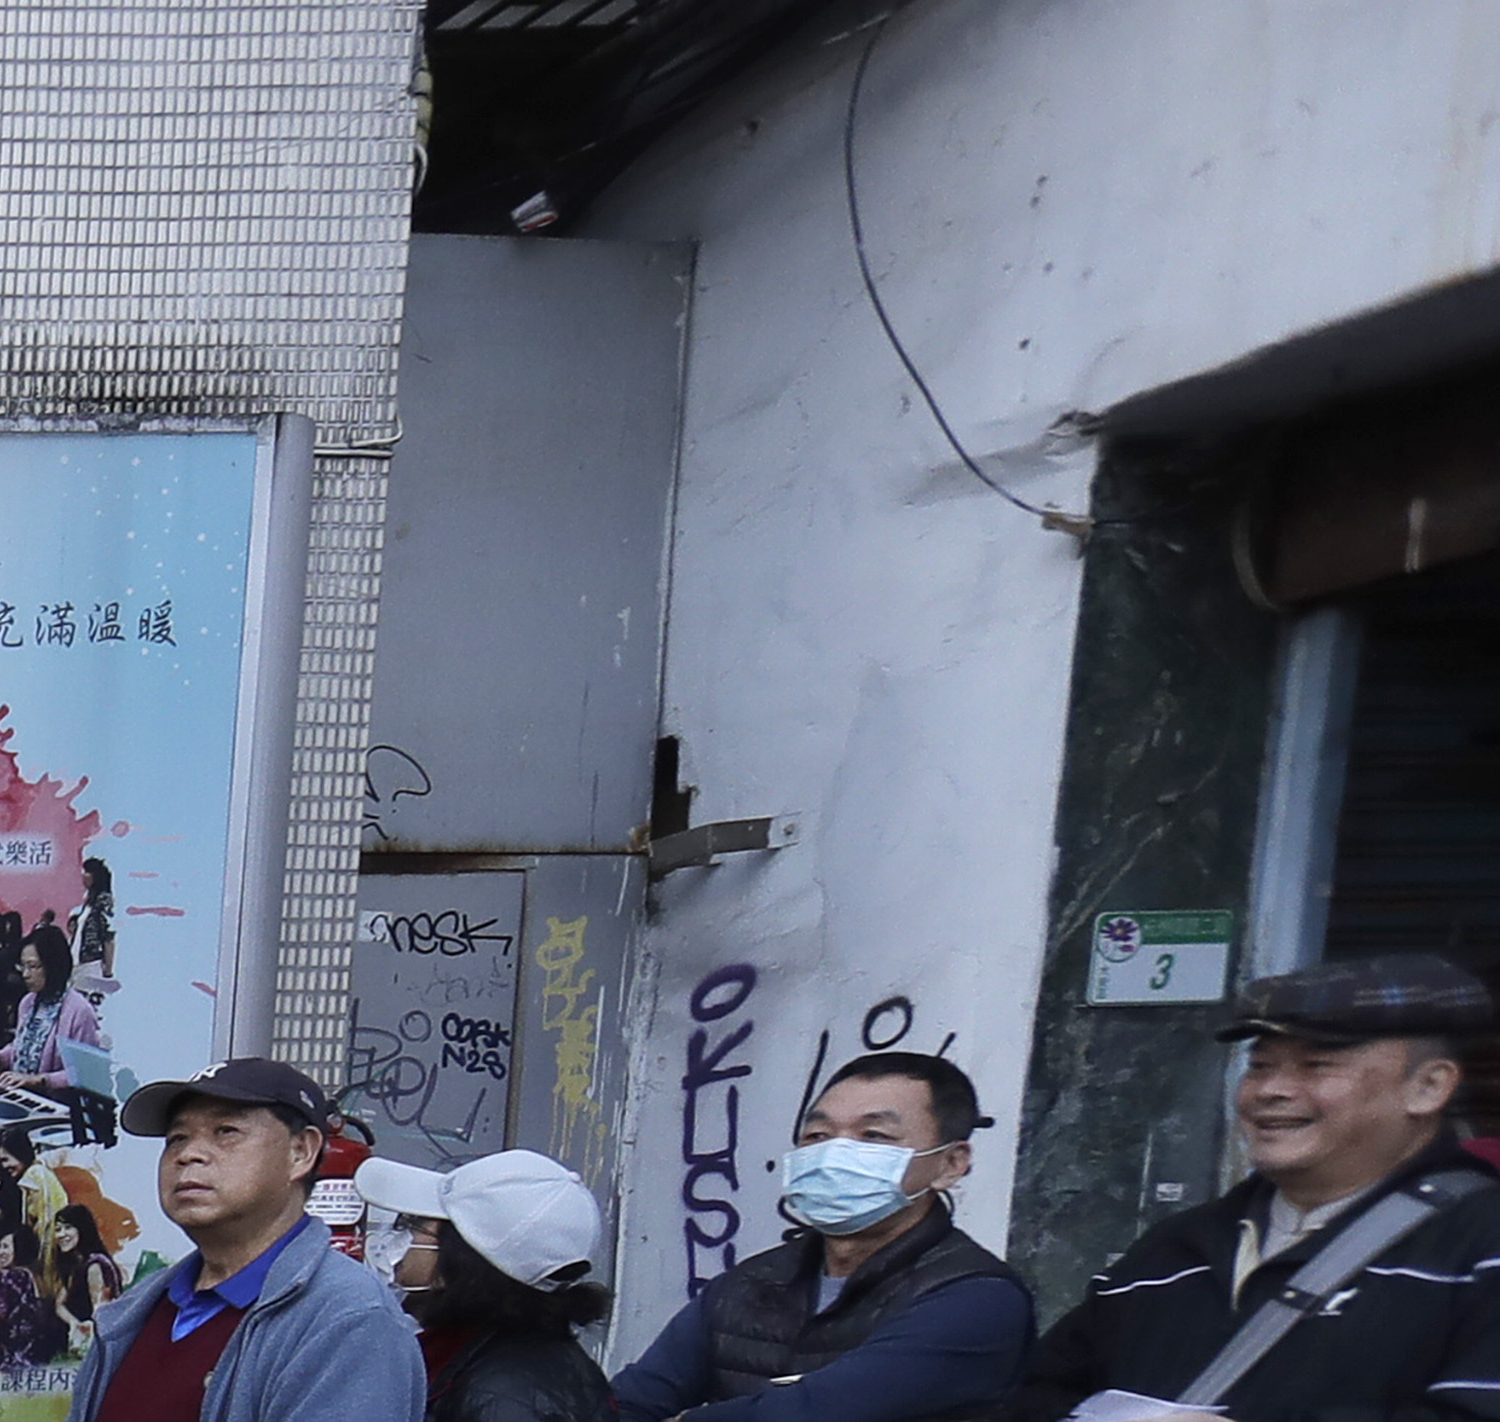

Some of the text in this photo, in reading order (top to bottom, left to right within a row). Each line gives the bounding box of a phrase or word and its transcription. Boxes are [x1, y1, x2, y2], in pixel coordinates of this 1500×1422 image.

[1148, 953, 1175, 991] 3
[1, 1367, 78, 1392] 課程內
